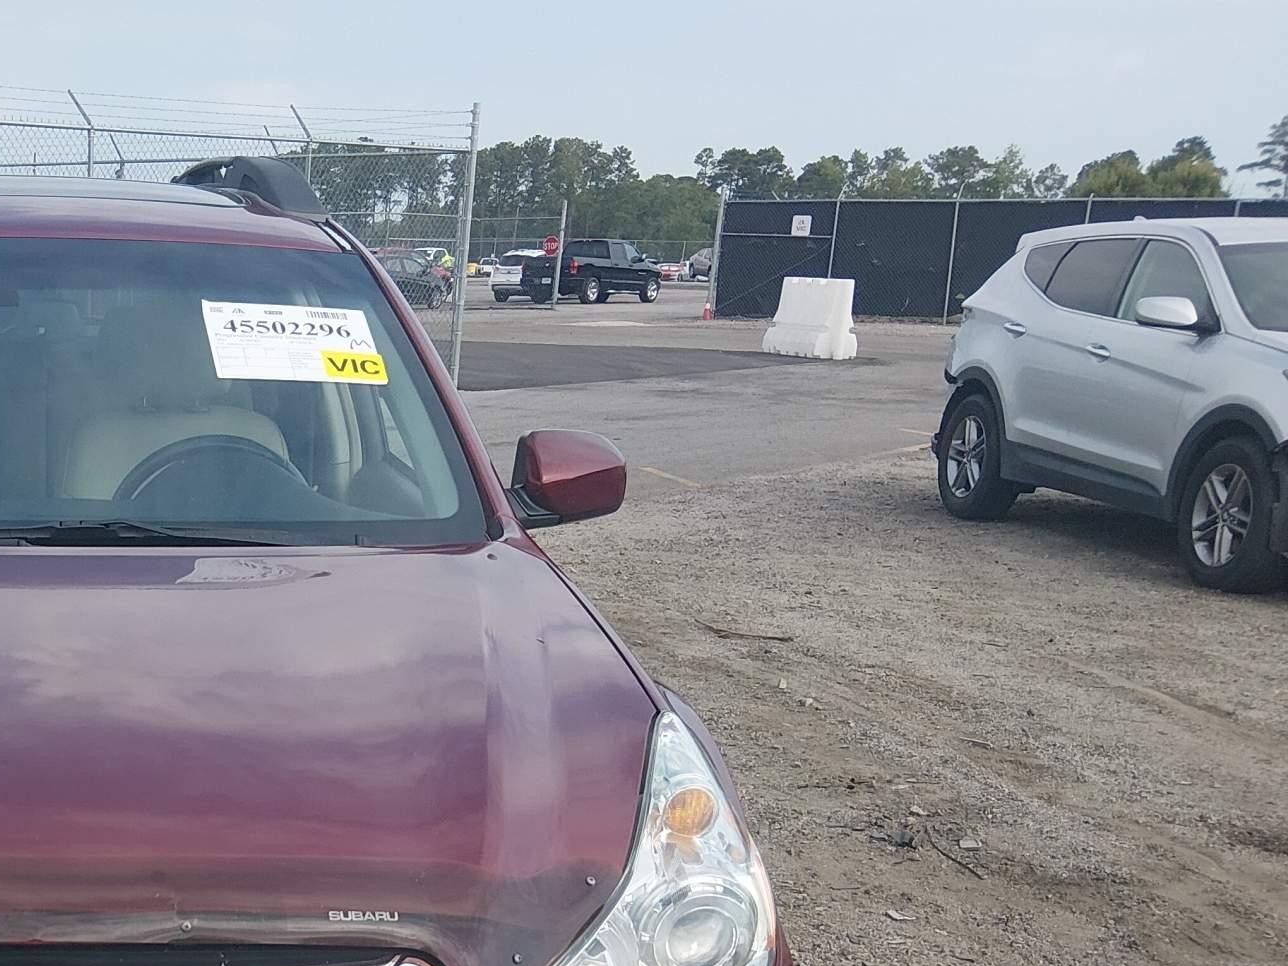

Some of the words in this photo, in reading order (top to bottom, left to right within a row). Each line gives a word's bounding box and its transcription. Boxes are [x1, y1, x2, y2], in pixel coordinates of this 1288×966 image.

[544, 242, 559, 251] STOP
[223, 319, 351, 339] 45502296
[327, 357, 381, 375] VIC
[328, 911, 399, 922] SUBARU
